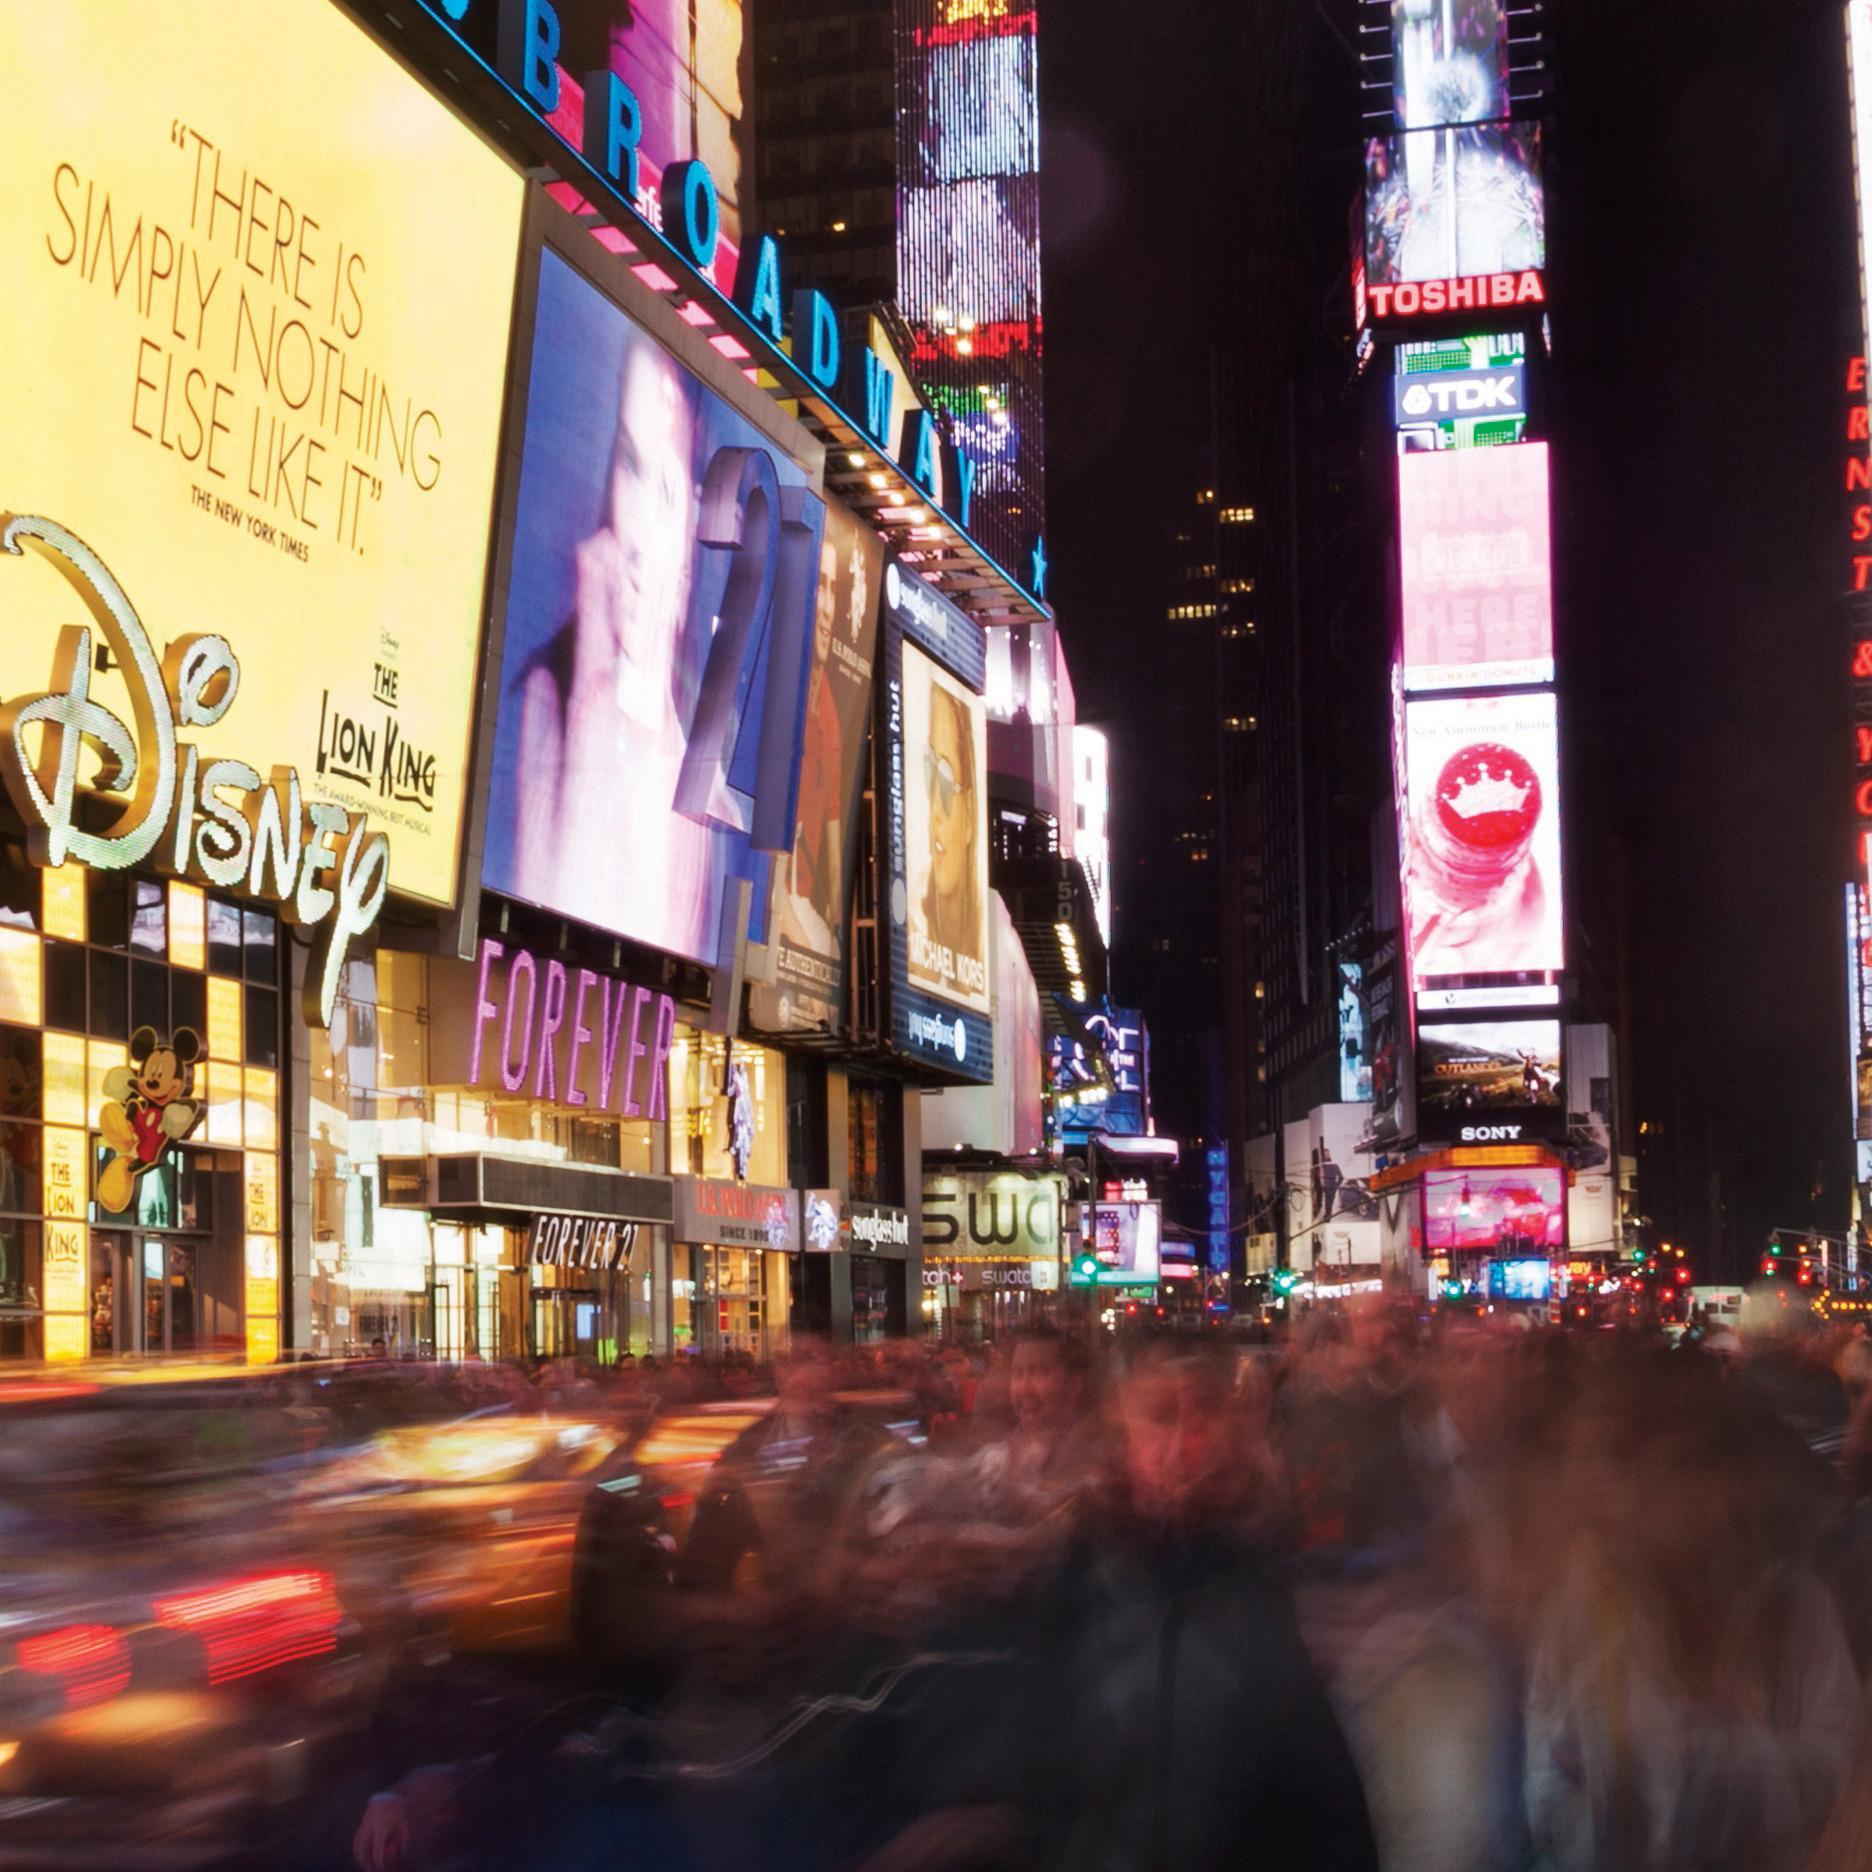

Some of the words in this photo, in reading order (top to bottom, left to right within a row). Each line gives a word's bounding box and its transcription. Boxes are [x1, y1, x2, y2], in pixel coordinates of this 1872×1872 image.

[332, 241, 366, 340] IS
[1369, 270, 1546, 318] TOSHIBA
[47, 162, 222, 350] SIMPLY
[234, 285, 443, 491] NOTHING
[1427, 375, 1517, 411] TDK
[132, 336, 235, 479] ELSE
[249, 406, 326, 529] LIKE
[190, 484, 212, 513] THE
[215, 496, 243, 527] NEW
[246, 514, 276, 547] YORK
[279, 529, 309, 564] TIMES
[373, 661, 398, 701] THE
[910, 928, 955, 980] MICHAEL
[955, 952, 985, 992] KORS
[469, 938, 676, 1122] FOREVER
[1460, 1125, 1522, 1141] SONY
[50, 1163, 71, 1182] THE
[725, 1186, 754, 1219] POLO
[531, 1214, 614, 1269] FOREVER
[617, 1223, 641, 1271] 21
